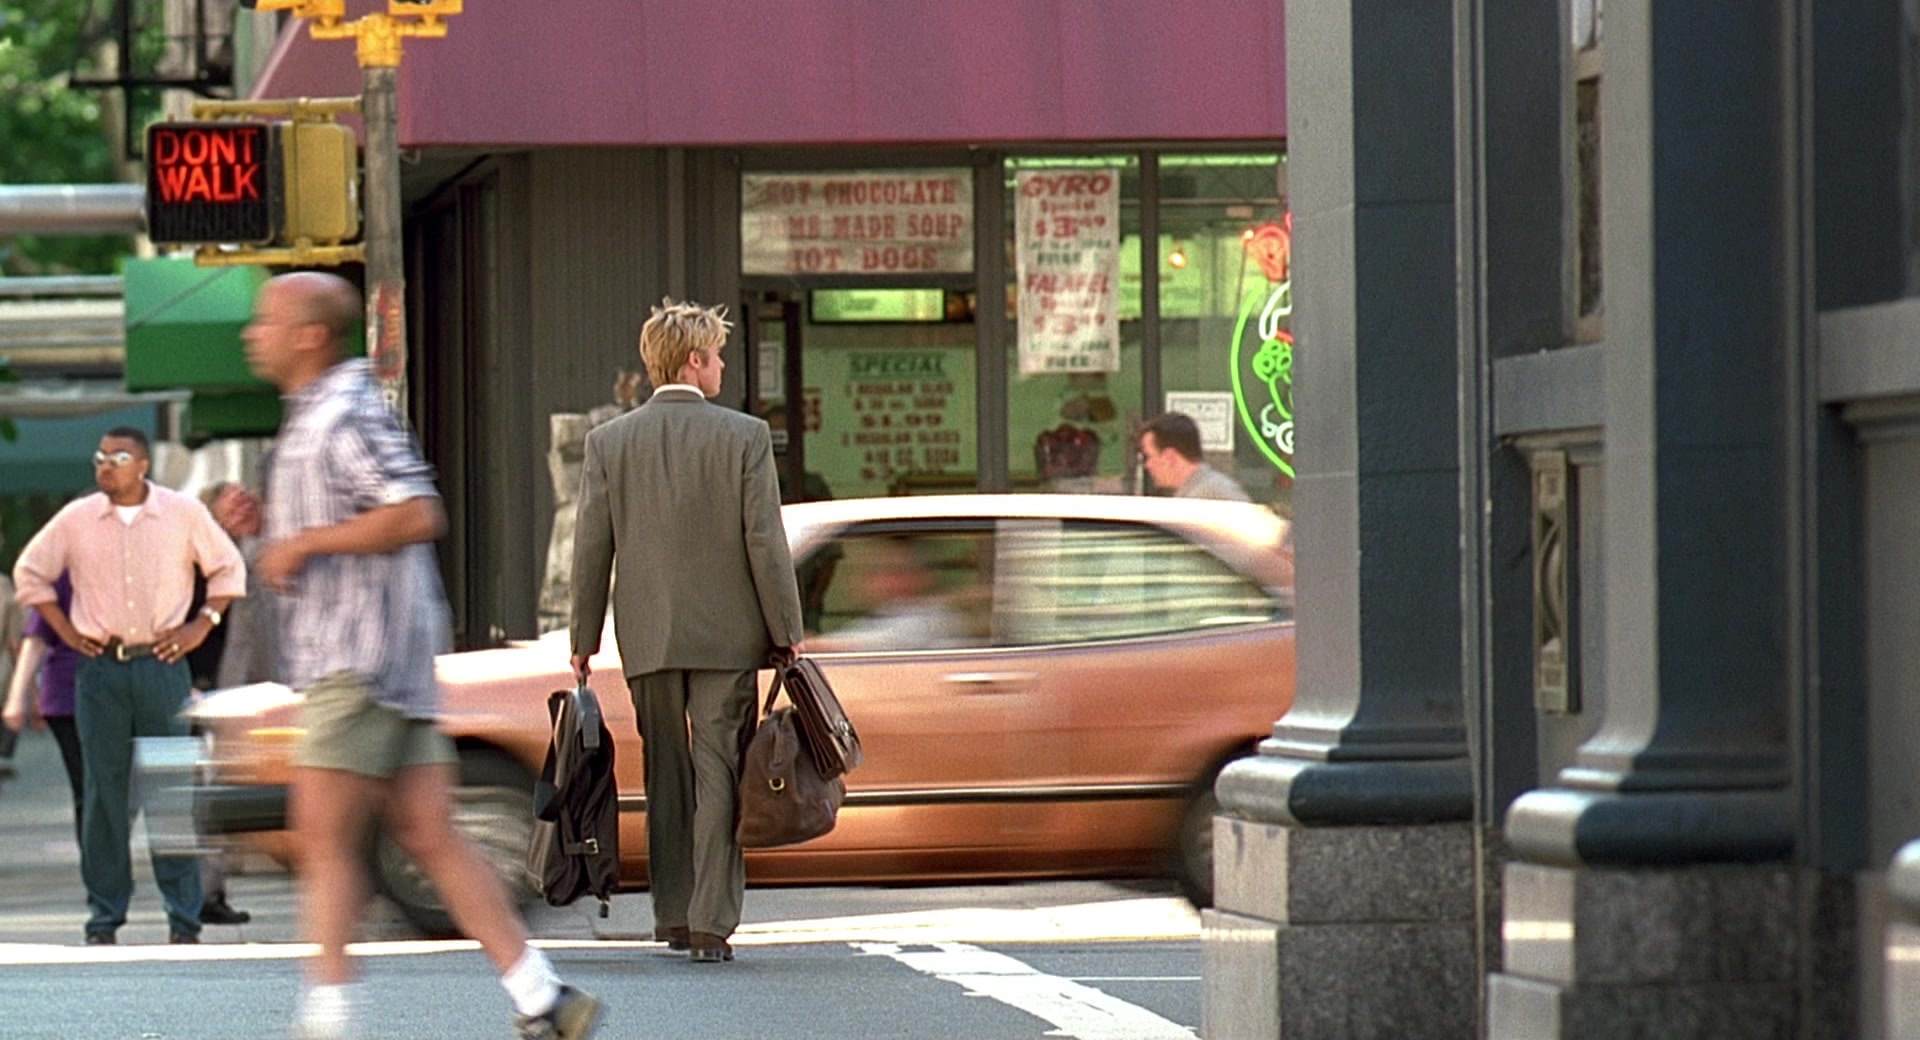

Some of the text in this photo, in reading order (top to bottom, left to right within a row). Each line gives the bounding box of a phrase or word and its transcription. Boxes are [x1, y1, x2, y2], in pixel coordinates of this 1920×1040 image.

[155, 129, 259, 165] DONT
[156, 165, 260, 203] WALK
[823, 180, 957, 205] CHOCOLATE
[1024, 174, 1111, 197] GYRO
[834, 214, 895, 238] MADE
[907, 214, 964, 238] SOUP
[862, 248, 938, 269] DOGS
[1026, 272, 1109, 294] FALAFEL
[850, 354, 945, 374] SPECIAL
